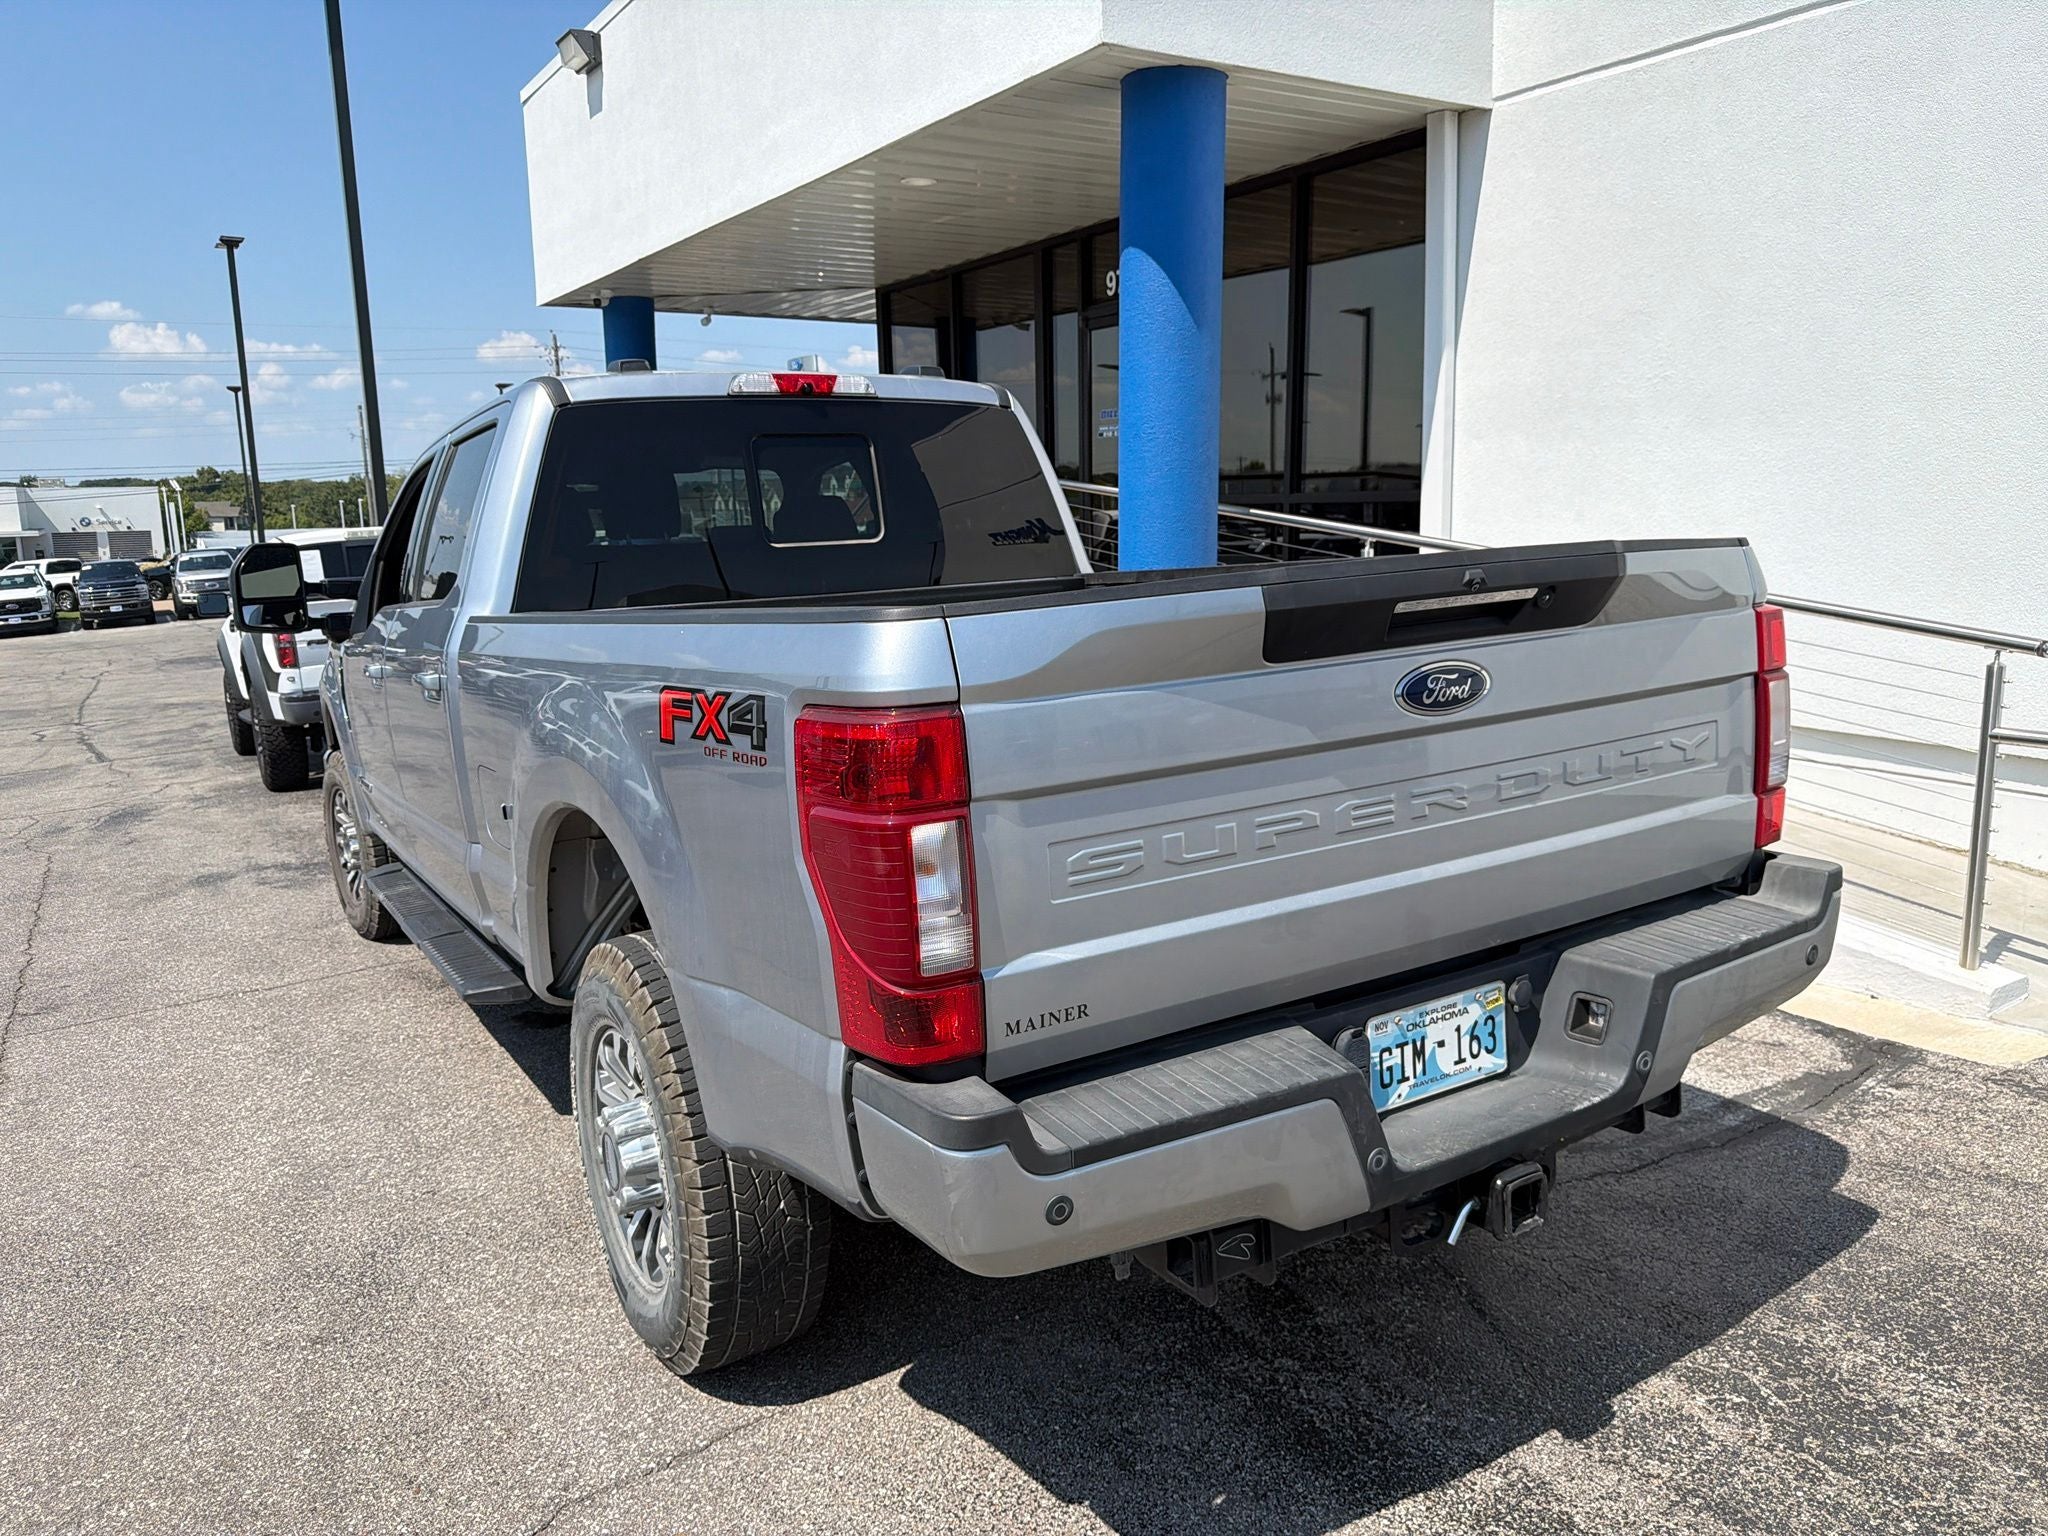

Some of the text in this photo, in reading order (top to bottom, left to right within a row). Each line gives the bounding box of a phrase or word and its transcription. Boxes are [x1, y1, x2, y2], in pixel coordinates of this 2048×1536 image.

[1422, 673, 1472, 704] Ford
[659, 685, 768, 752] FX4
[703, 746, 768, 767] OFF ROAD
[1066, 731, 1710, 888] SUPER DUTY
[1004, 1003, 1090, 1037] MAINER
[1406, 1007, 1470, 1033] OKLAHOMA
[1418, 1002, 1458, 1019] EXPLORE
[1374, 1020, 1389, 1032] NOV
[1407, 1065, 1473, 1091] TRAVELOK.COM
